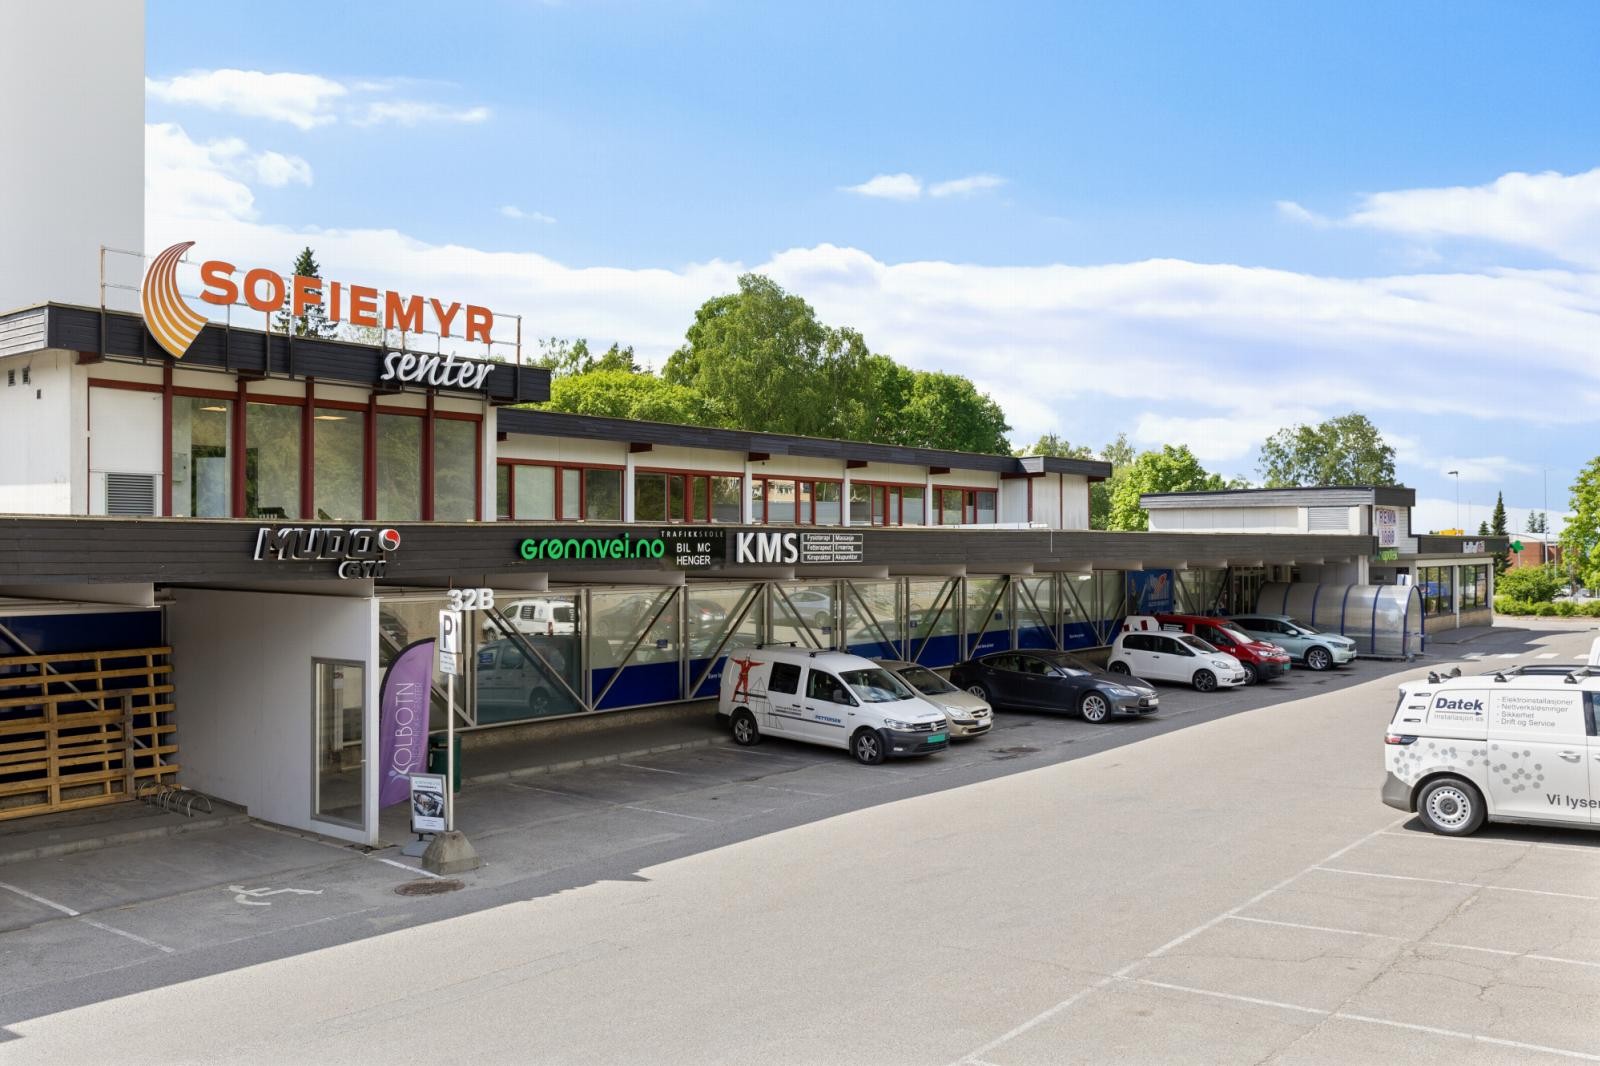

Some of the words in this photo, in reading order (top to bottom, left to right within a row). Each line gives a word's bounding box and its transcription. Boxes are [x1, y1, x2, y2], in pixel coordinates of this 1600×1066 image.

[199, 260, 494, 344] SOFIEMYR
[380, 350, 496, 390] senter
[254, 528, 379, 560] MUDO
[676, 543, 691, 553] BIL
[697, 543, 711, 553] MC
[736, 532, 799, 564] KMS
[338, 560, 387, 579] GYM
[676, 555, 711, 565] HENGER
[447, 588, 495, 612] 32B
[443, 615, 453, 648] P
[1435, 697, 1484, 711] Datek
[1501, 696, 1573, 707] Elektroinstallasjoner
[391, 682, 417, 776] KOLBOTN
[1501, 718, 1515, 726] Drift
[1529, 719, 1556, 727] Service
[1546, 793, 1560, 806] Vi
[1566, 795, 1600, 810] lyse
